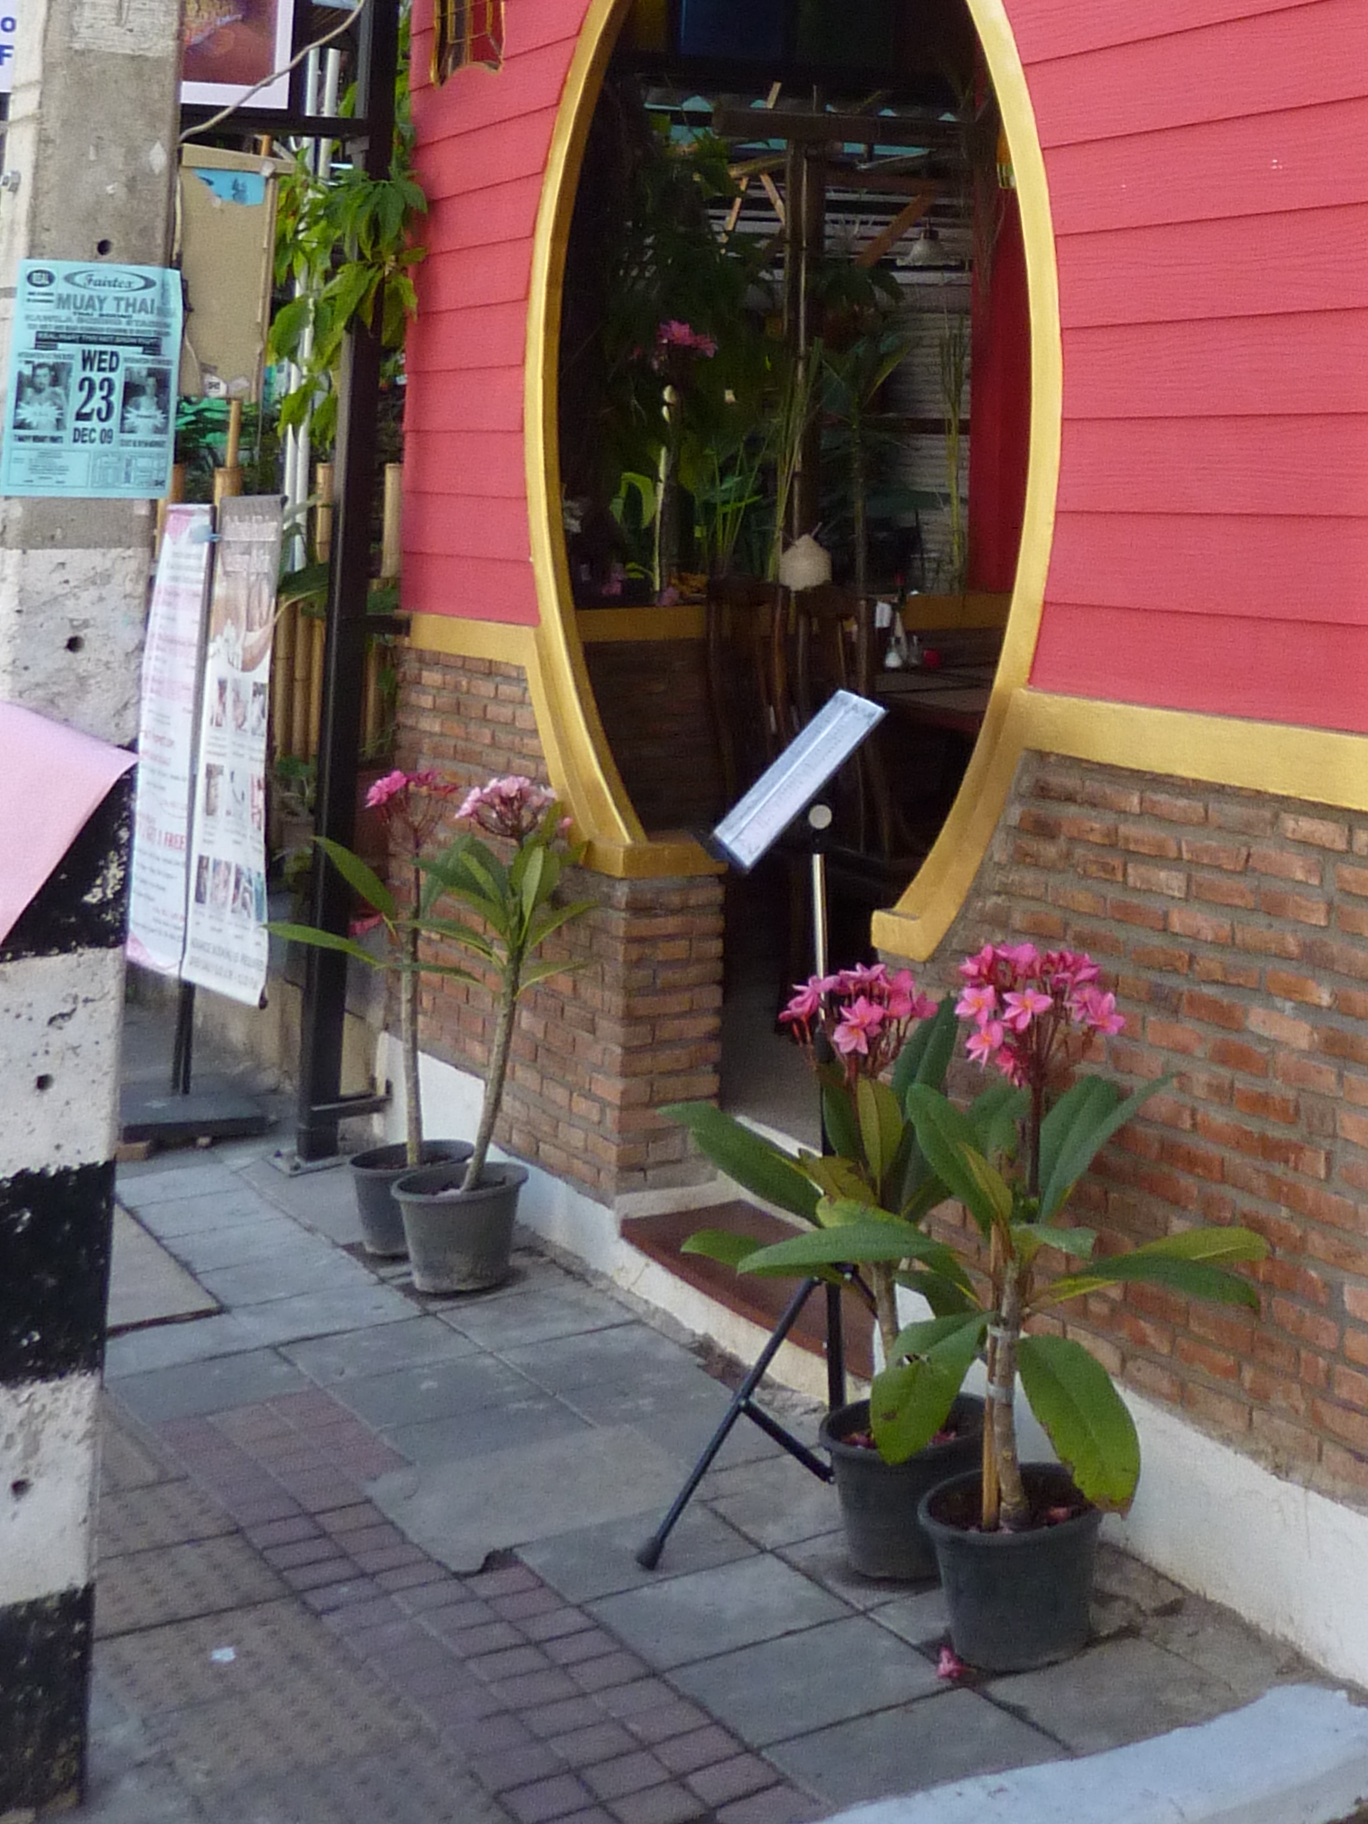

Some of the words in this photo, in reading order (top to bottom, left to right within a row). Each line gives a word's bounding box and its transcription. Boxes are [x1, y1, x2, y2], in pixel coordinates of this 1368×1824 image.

[56, 293, 109, 312] MUAY
[113, 296, 157, 315] THAI
[81, 349, 120, 373] WED
[75, 376, 116, 422] 23
[72, 428, 97, 444] DEC
[99, 428, 114, 444] 09
